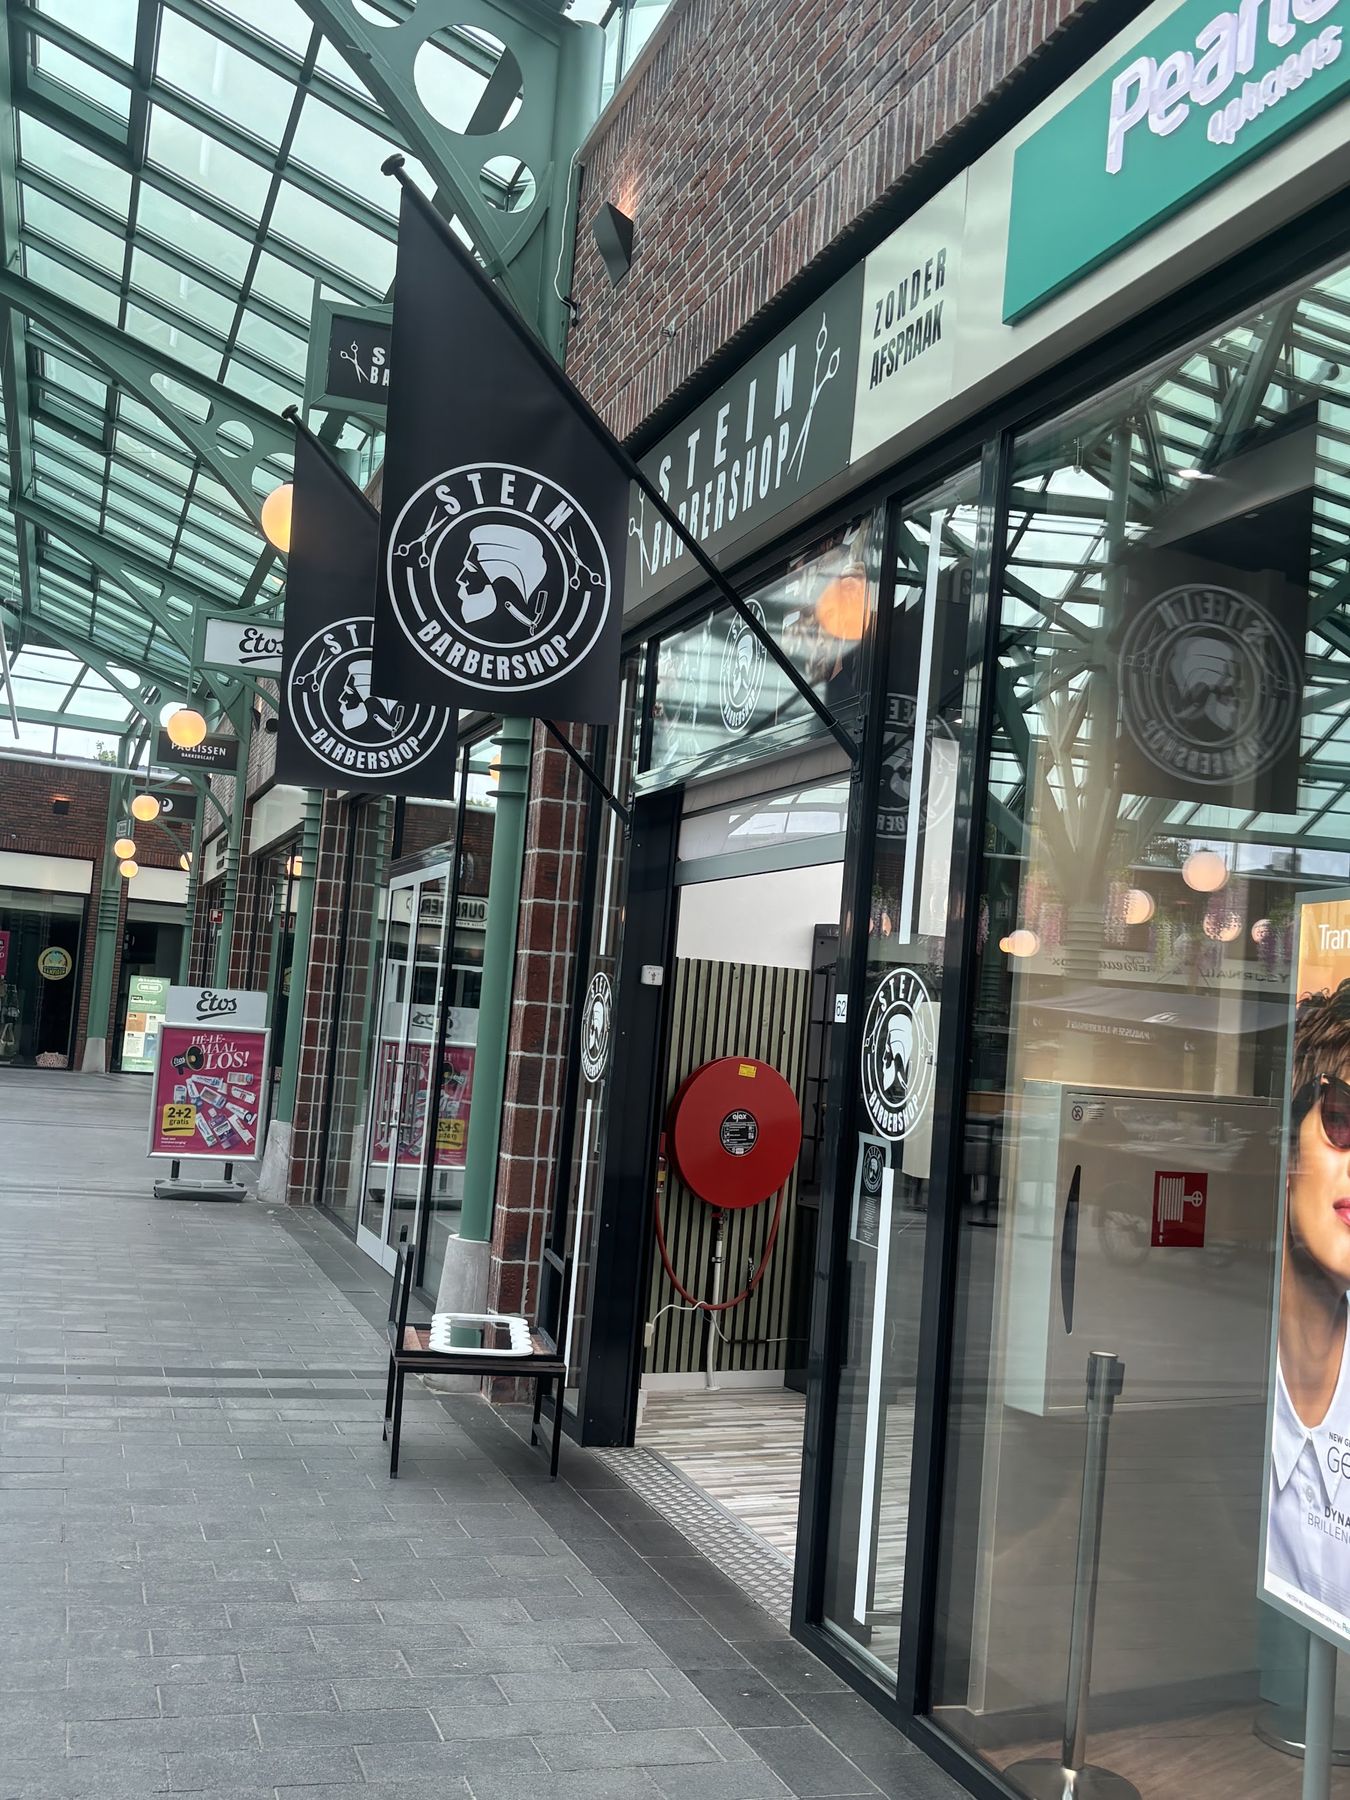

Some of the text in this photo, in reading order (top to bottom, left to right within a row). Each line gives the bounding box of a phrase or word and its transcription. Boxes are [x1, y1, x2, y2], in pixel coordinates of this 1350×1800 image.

[1106, 0, 1340, 174] Pear
[873, 247, 946, 338] ZONDER
[869, 300, 944, 391] AFSPRAAK
[658, 344, 797, 503] STEIN
[435, 473, 573, 533] STEIN
[650, 421, 790, 575] BARBERSHOP
[239, 627, 284, 655] Etos
[323, 624, 375, 655] ST
[417, 617, 571, 681] BARBERSHOP
[310, 726, 423, 772] BARBERSHOP
[1318, 923, 1350, 951] Tran
[196, 990, 237, 1013] Etos
[836, 999, 847, 1017] 62
[878, 974, 924, 1014] STEIN
[200, 1042, 237, 1055] MAAL
[204, 1051, 250, 1070] LOS!
[168, 1107, 192, 1119] 2+2
[169, 1118, 189, 1126] gratis
[732, 1112, 747, 1123] ajax
[868, 1091, 920, 1133] BARBERSHOP
[1328, 1431, 1343, 1445] NEW
[1307, 1512, 1350, 1545] BRILLEN
[1324, 1505, 1350, 1528] DYNA
